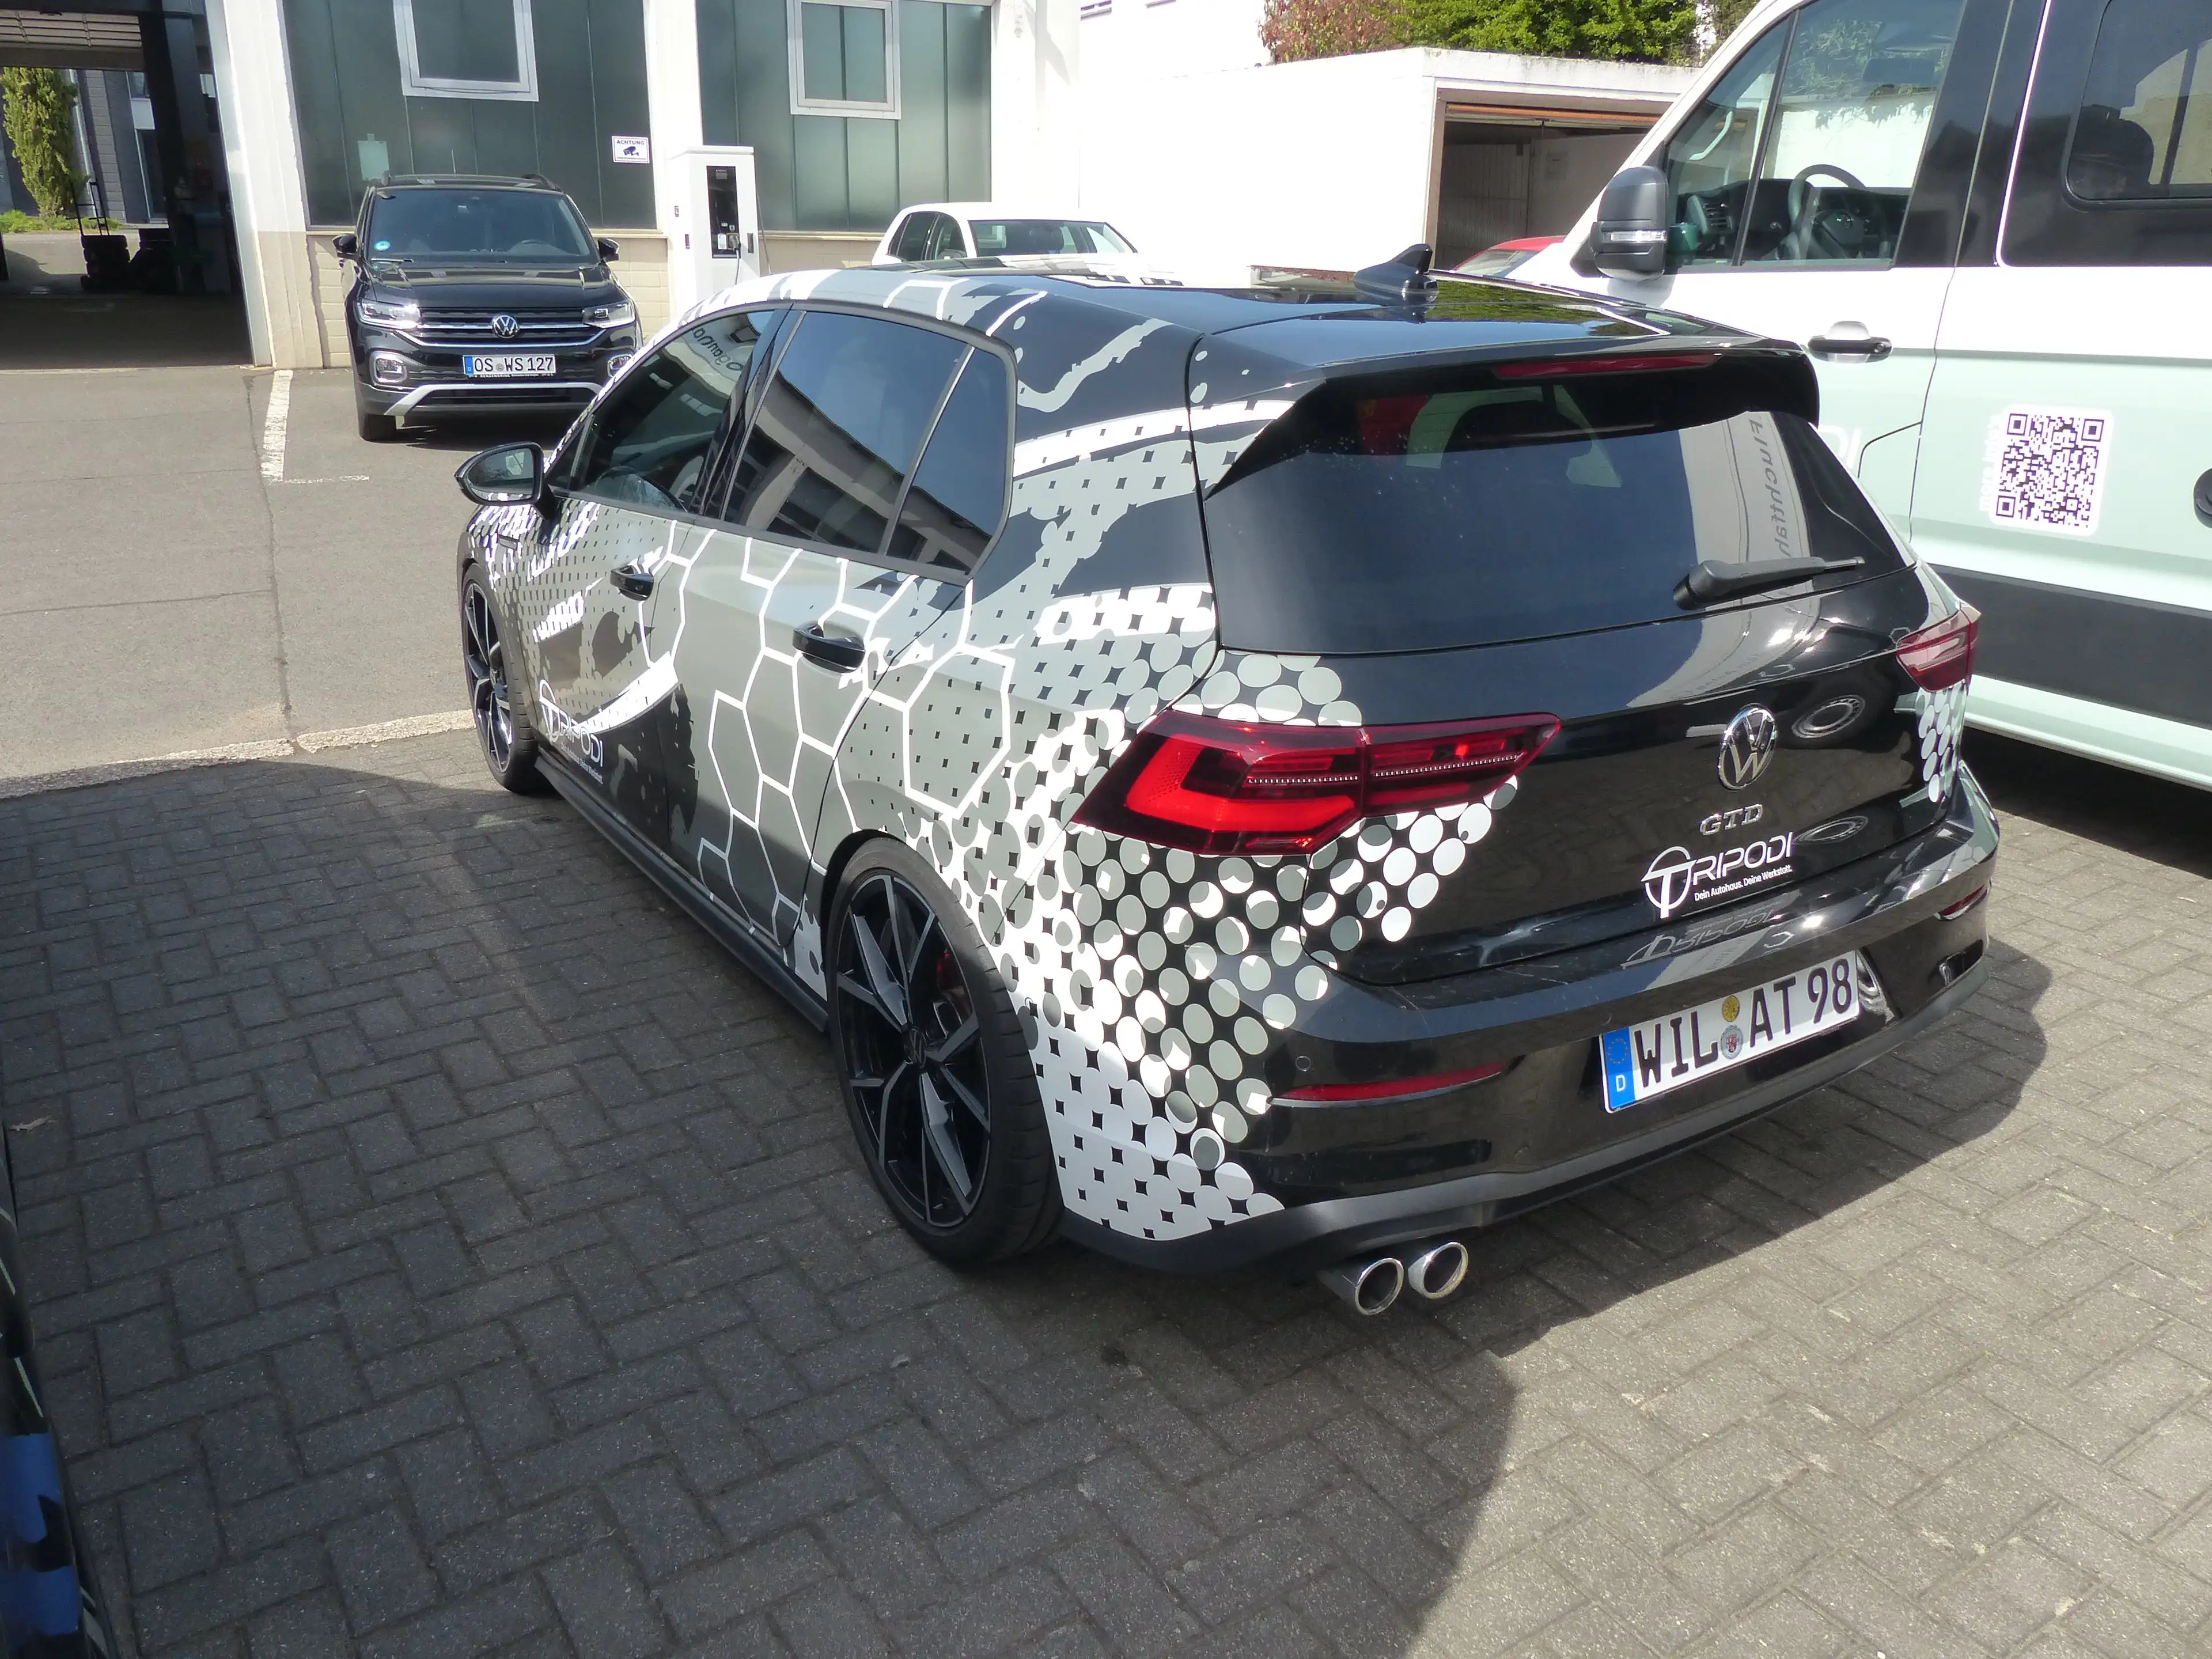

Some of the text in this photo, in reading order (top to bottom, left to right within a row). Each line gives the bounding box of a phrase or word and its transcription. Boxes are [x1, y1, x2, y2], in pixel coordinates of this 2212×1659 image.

[475, 358, 493, 372] OS
[504, 357, 524, 372] WS
[528, 357, 553, 371] 127
[1699, 804, 1763, 835] GTD
[1641, 832, 1793, 919] TRIPODI
[1694, 864, 1793, 902] Dein Autohaus. Deine Werkstatt.
[1615, 958, 1852, 1093] D WIL AT 98
